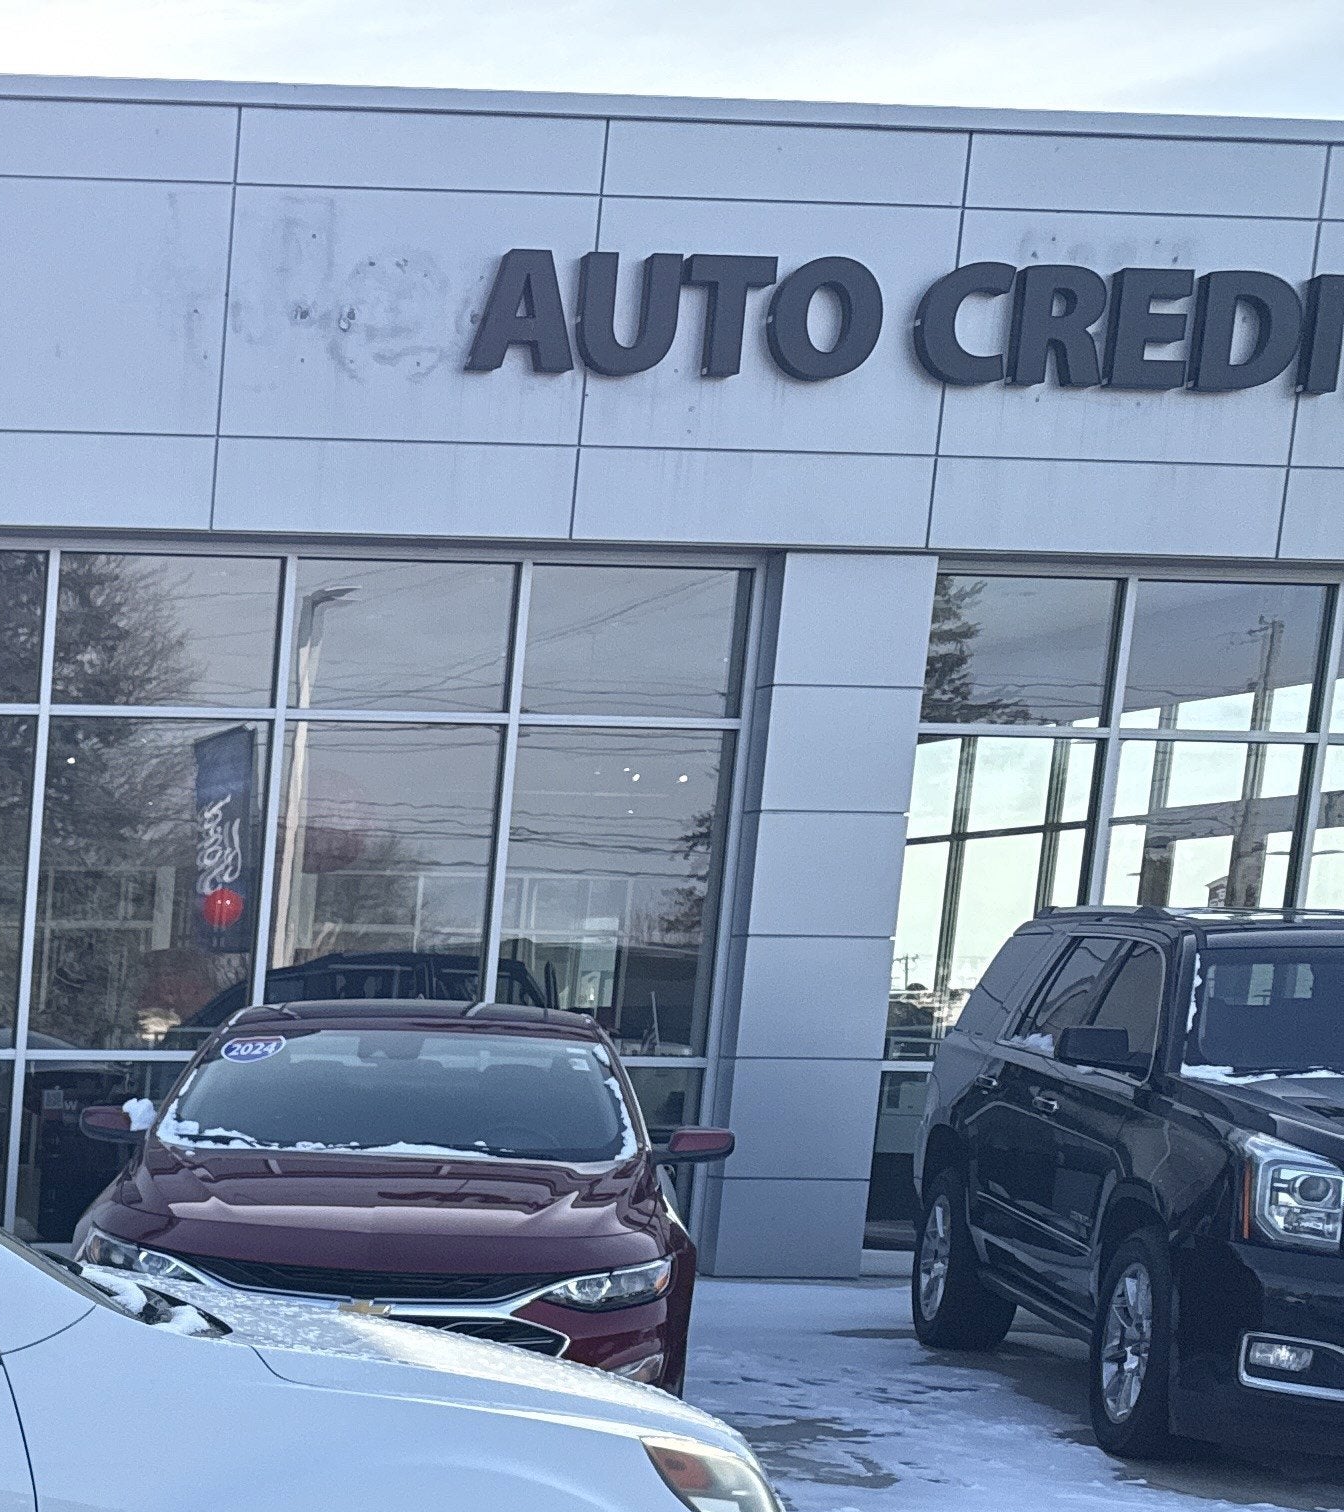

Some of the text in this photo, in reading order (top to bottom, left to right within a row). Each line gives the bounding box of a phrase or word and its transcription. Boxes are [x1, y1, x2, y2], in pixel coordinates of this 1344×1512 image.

[465, 248, 1344, 396] AUTO CREDI
[227, 1041, 278, 1056] 2024
